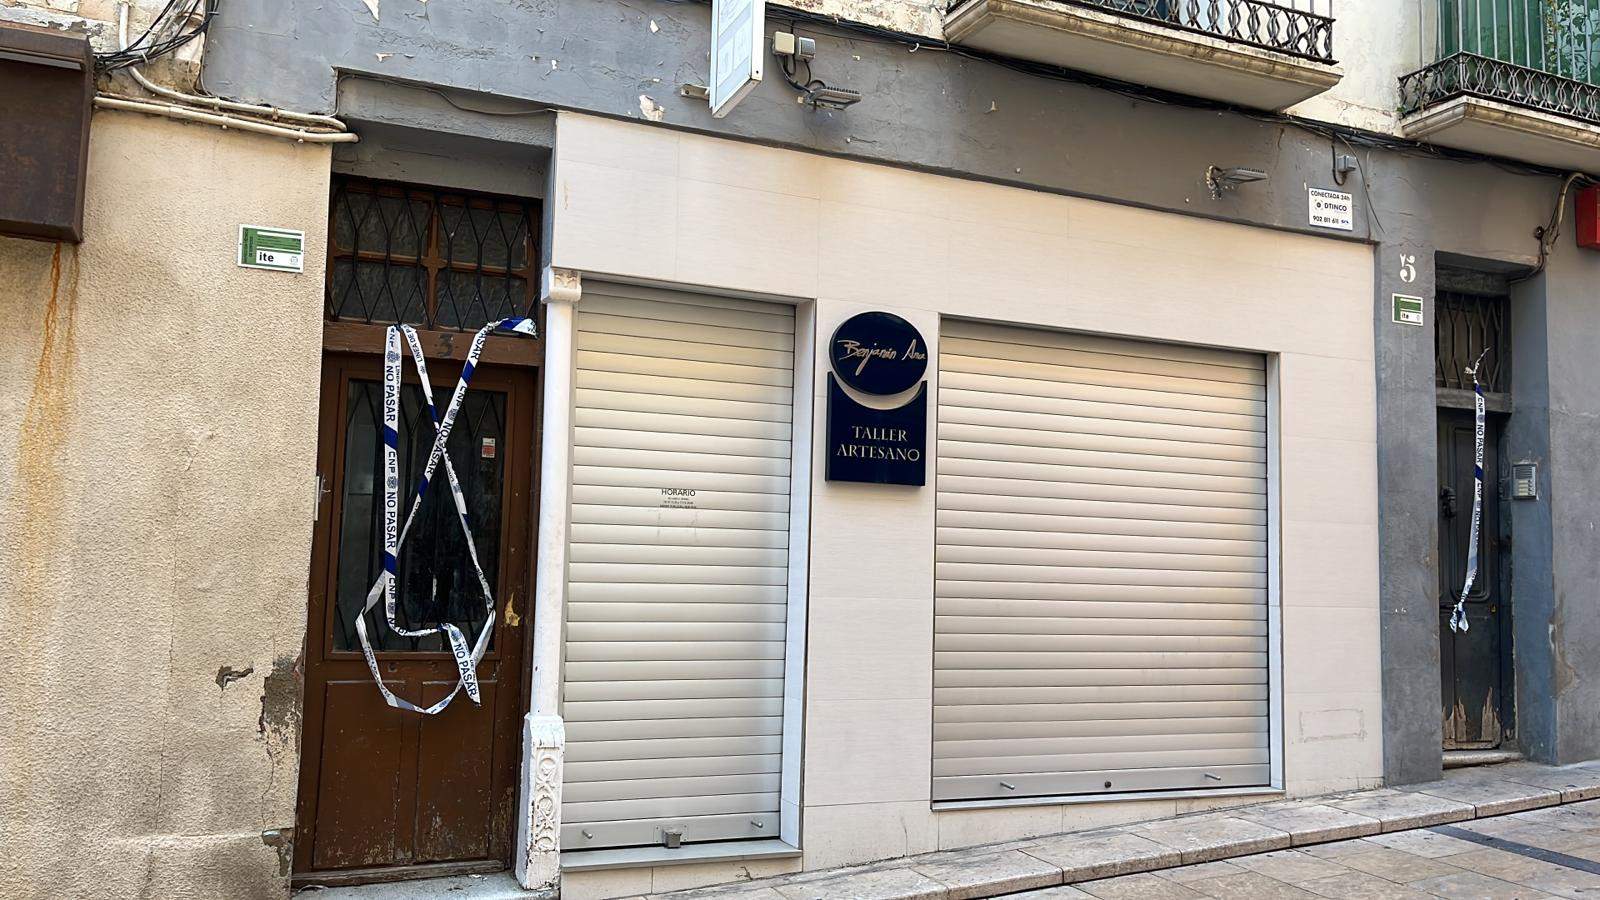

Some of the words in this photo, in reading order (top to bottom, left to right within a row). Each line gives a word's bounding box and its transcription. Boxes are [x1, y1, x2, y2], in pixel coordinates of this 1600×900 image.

[1310, 190, 1340, 199] CONECTADA
[259, 252, 274, 262] ite
[385, 365, 394, 383] NO
[385, 384, 396, 422] PASAR
[852, 425, 907, 442] TALLER
[837, 443, 920, 462] ARTESANO
[388, 451, 396, 473] CNP
[386, 491, 396, 508] NO
[661, 488, 696, 497] HORARIO
[386, 511, 396, 549] PASAR
[453, 643, 466, 659] NO
[459, 660, 477, 697] PASAR
